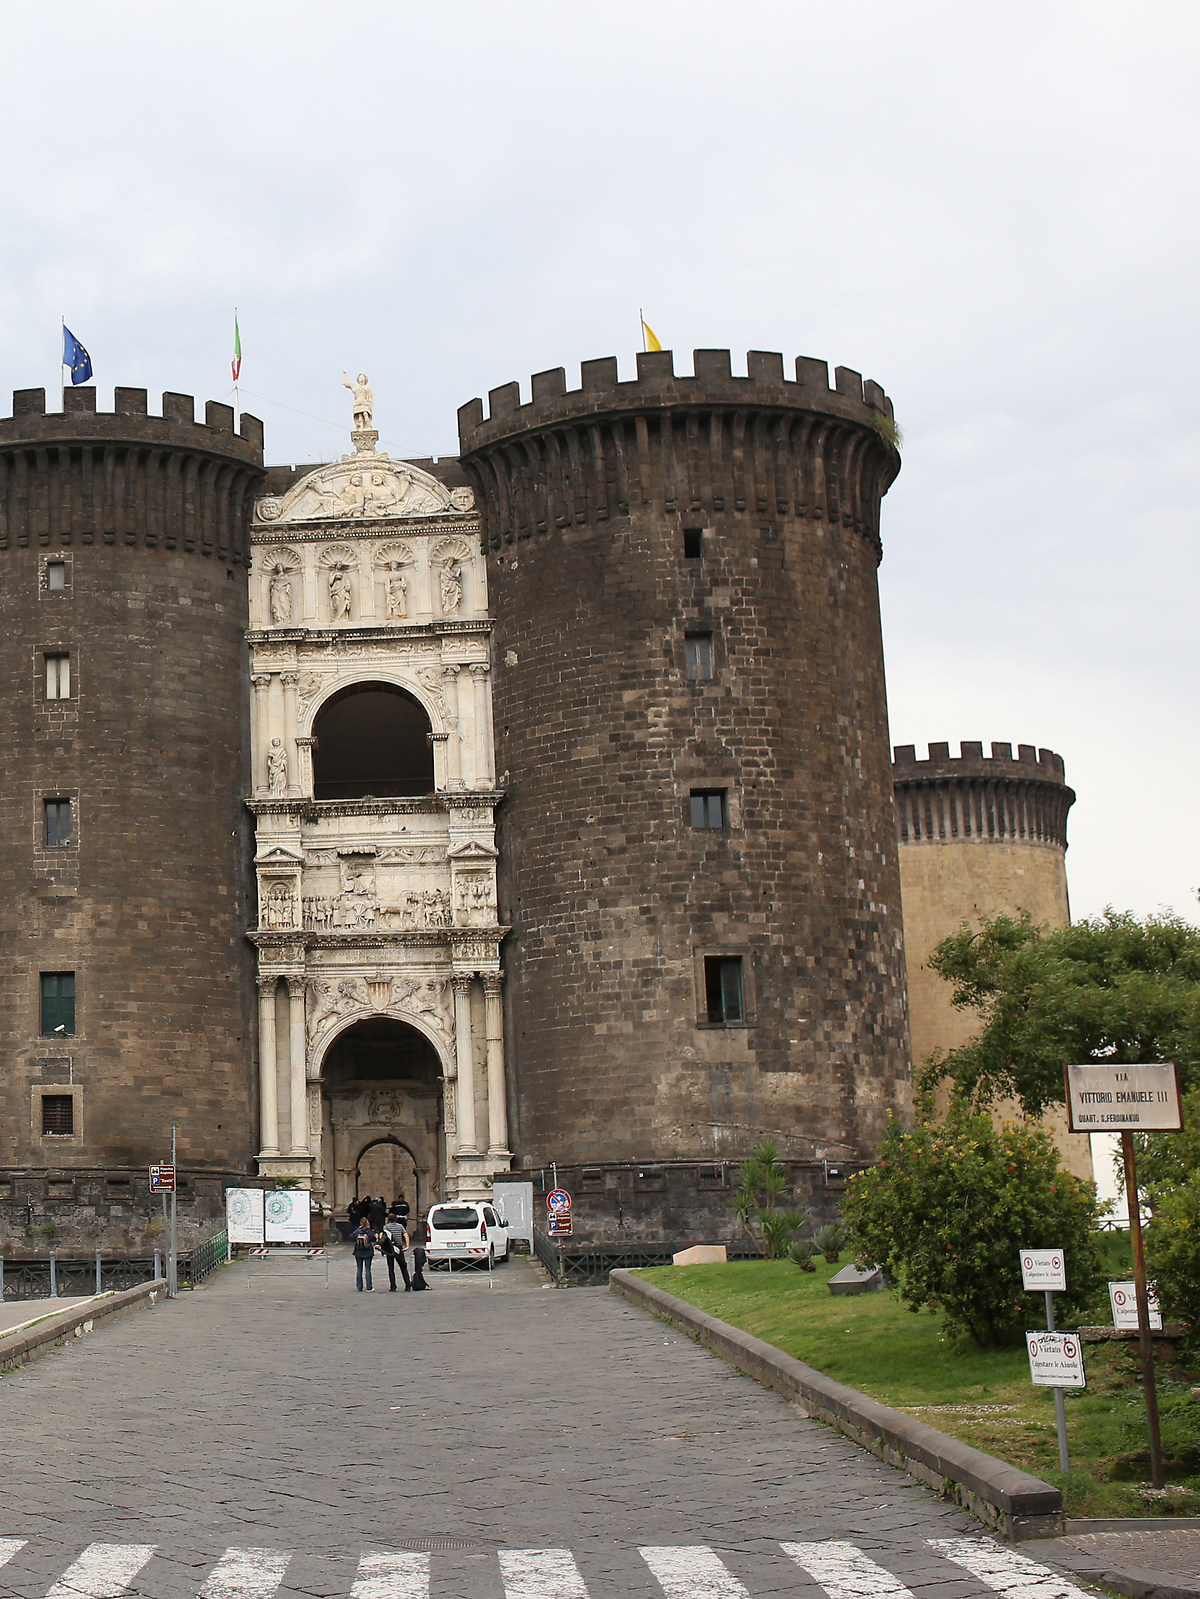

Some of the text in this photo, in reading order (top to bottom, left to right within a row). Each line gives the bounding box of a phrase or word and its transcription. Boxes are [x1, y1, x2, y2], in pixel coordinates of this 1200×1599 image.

[1115, 1073, 1128, 1081] VIA
[1079, 1091, 1168, 1103] VITTORIO EMANUELE III
[1039, 1345, 1061, 1353] Vietato
[1060, 1361, 1078, 1369] Aiuole
